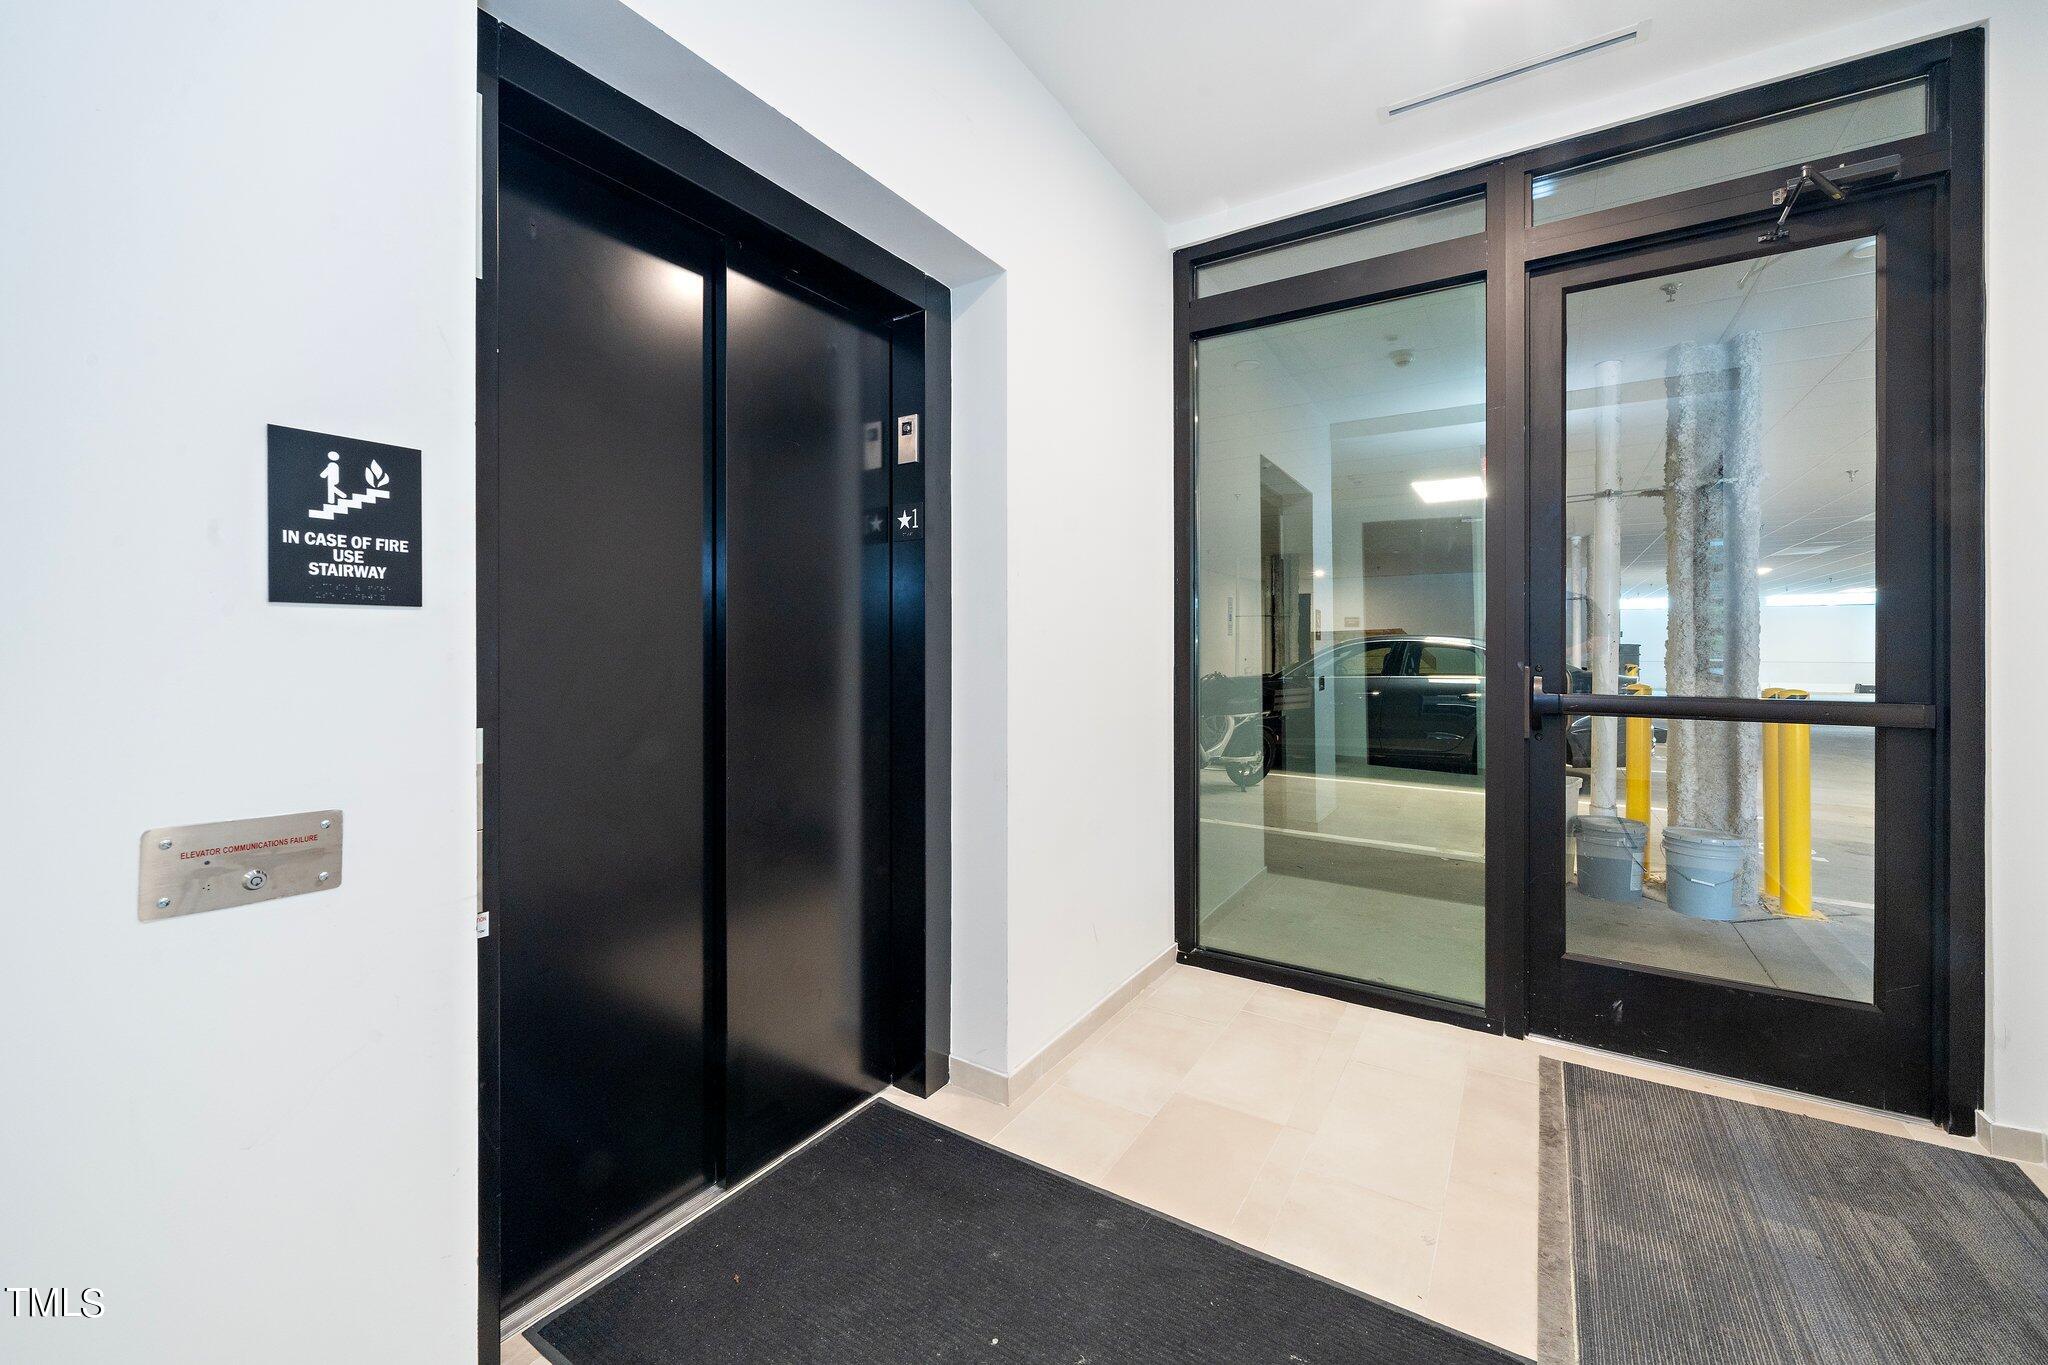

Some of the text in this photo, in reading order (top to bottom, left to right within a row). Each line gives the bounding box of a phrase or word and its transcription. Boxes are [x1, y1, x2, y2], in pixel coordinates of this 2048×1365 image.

[282, 529, 409, 553] IN CASE OF FIRE
[332, 548, 364, 563] USE
[308, 562, 387, 579] STAIRWAY
[180, 833, 319, 860] ELEVATOR COMMUNICATIONS FAILURE
